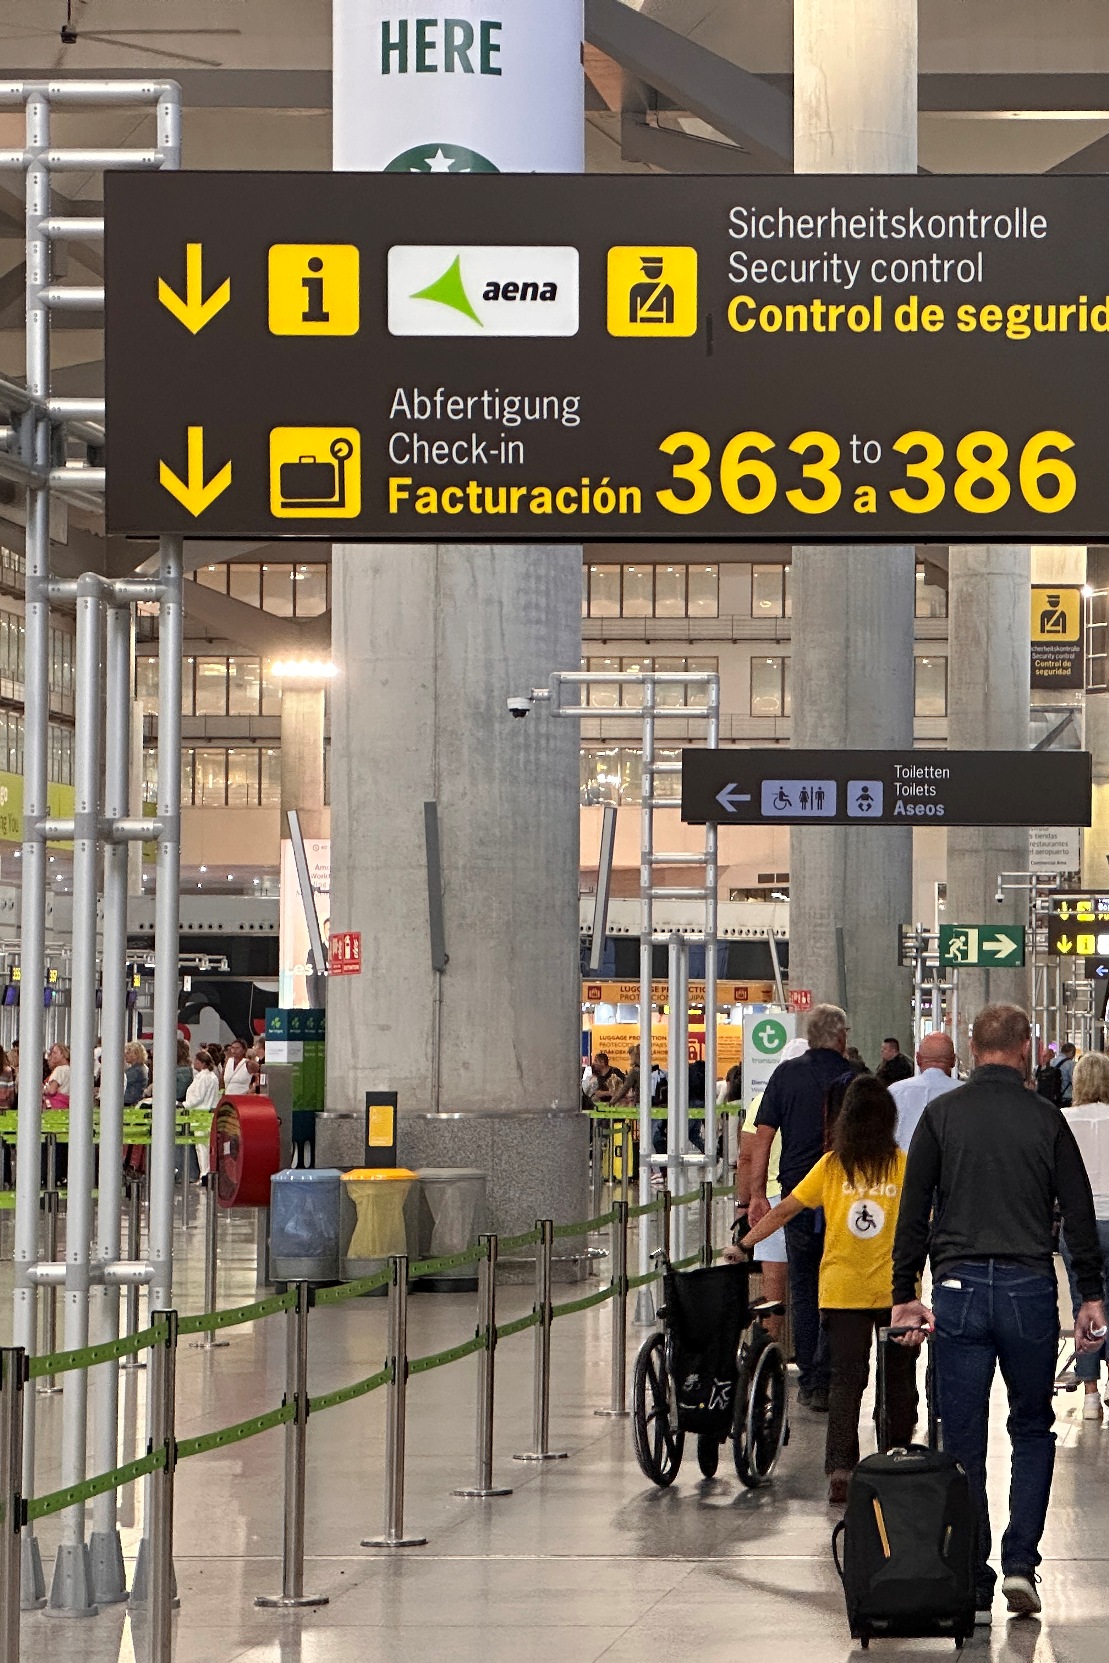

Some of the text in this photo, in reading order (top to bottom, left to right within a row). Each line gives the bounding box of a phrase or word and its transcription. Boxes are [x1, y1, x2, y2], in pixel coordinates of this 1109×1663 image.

[381, 18, 503, 77] HERE
[728, 206, 1048, 240] Sicherheitskontrolle
[728, 250, 983, 290] Security control
[482, 281, 558, 302] aena
[727, 294, 882, 333] Control
[894, 294, 945, 333] de
[389, 387, 581, 427] Abfertigung
[388, 431, 524, 465] Check-in
[849, 433, 882, 464] to
[655, 430, 842, 515] 363
[889, 430, 1077, 514] 386
[388, 476, 642, 515] Facturación
[853, 485, 877, 514] a
[1032, 652, 1054, 660] Security
[1035, 667, 1072, 676] seguridad
[894, 764, 950, 779] Toiletten
[893, 782, 937, 797] Toilets
[893, 799, 945, 816] Aseos
